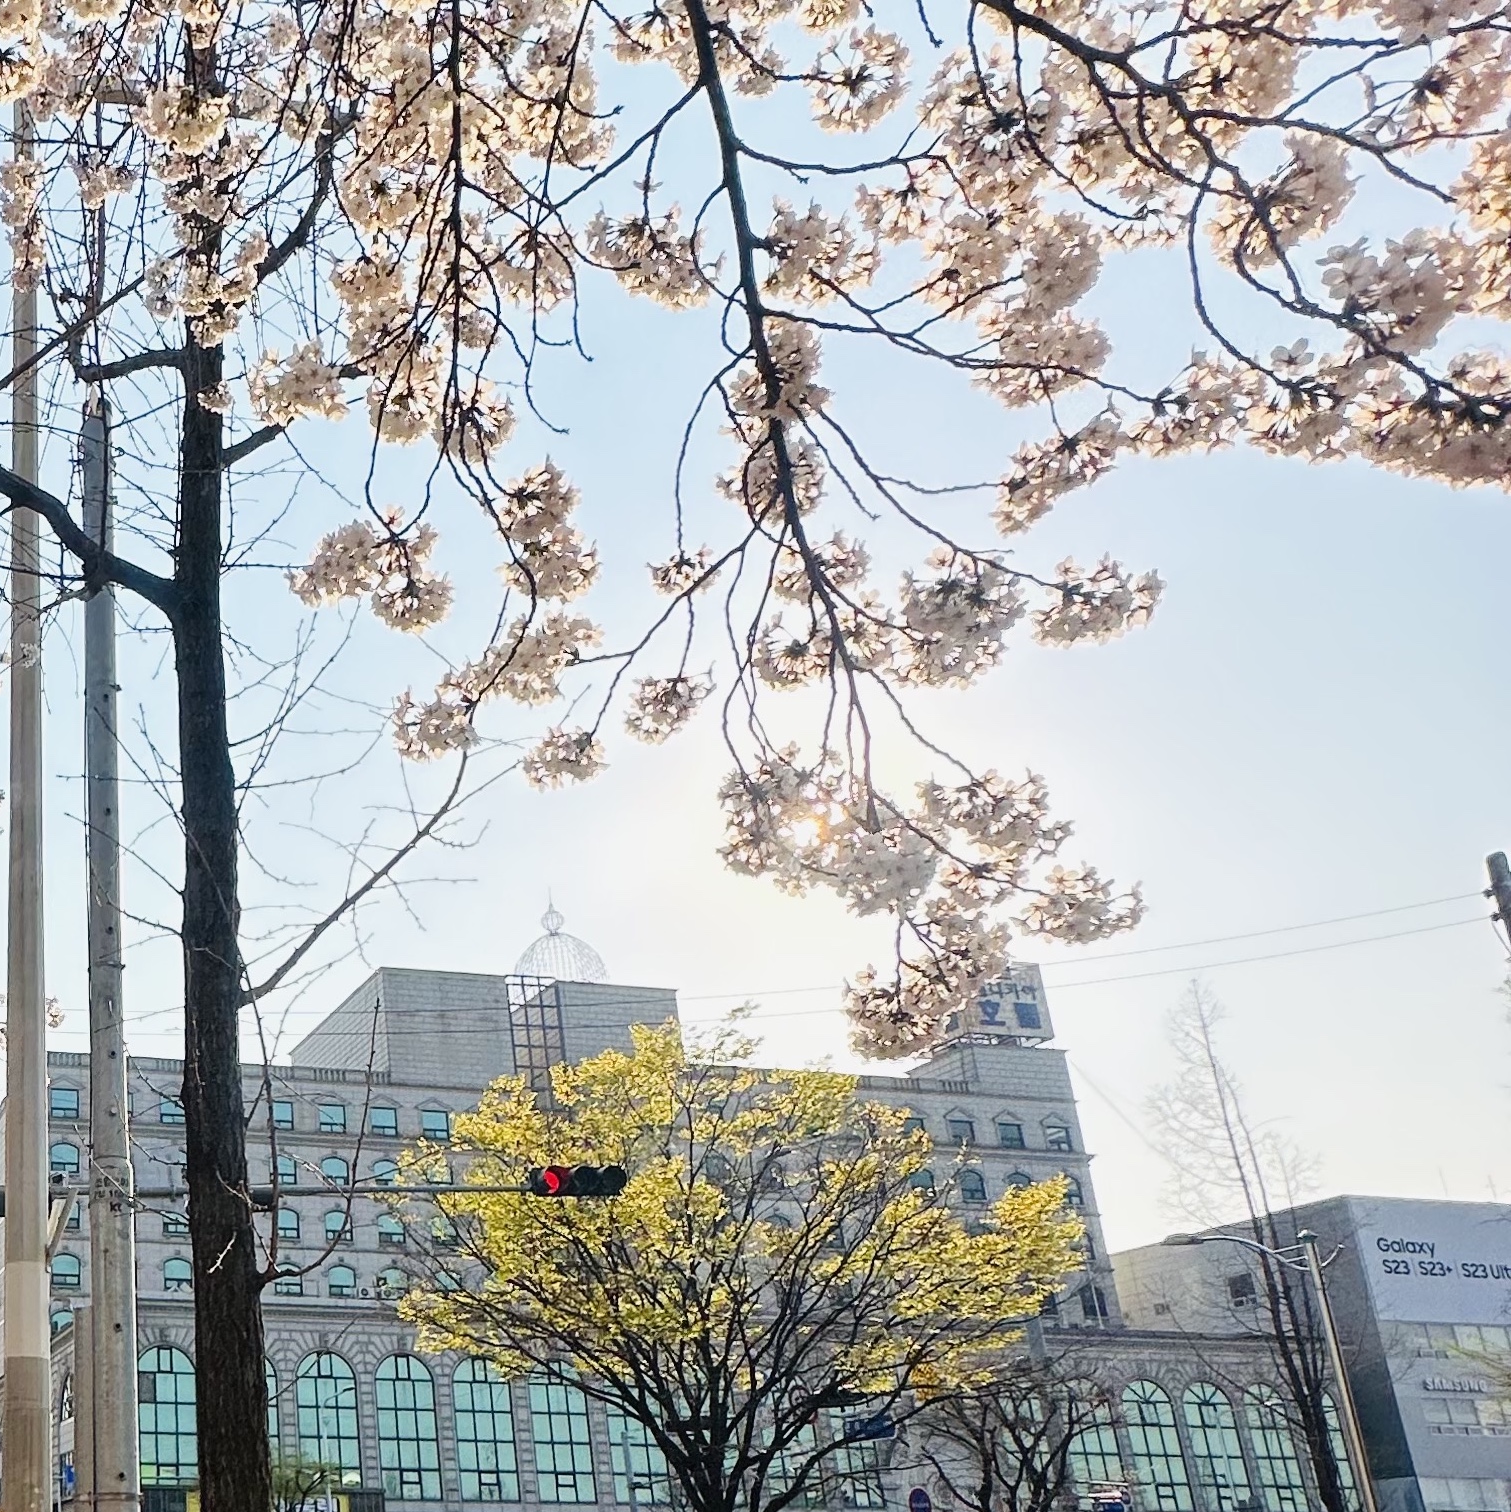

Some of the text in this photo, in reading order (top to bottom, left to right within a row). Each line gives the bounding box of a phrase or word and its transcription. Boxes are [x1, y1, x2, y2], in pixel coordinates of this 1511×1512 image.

[1376, 1237, 1435, 1258] Galaxy
[1382, 1259, 1411, 1275] S23
[1418, 1261, 1452, 1277] S23+
[1461, 1263, 1488, 1279] S23
[1424, 1378, 1488, 1393] SAMSUNG
